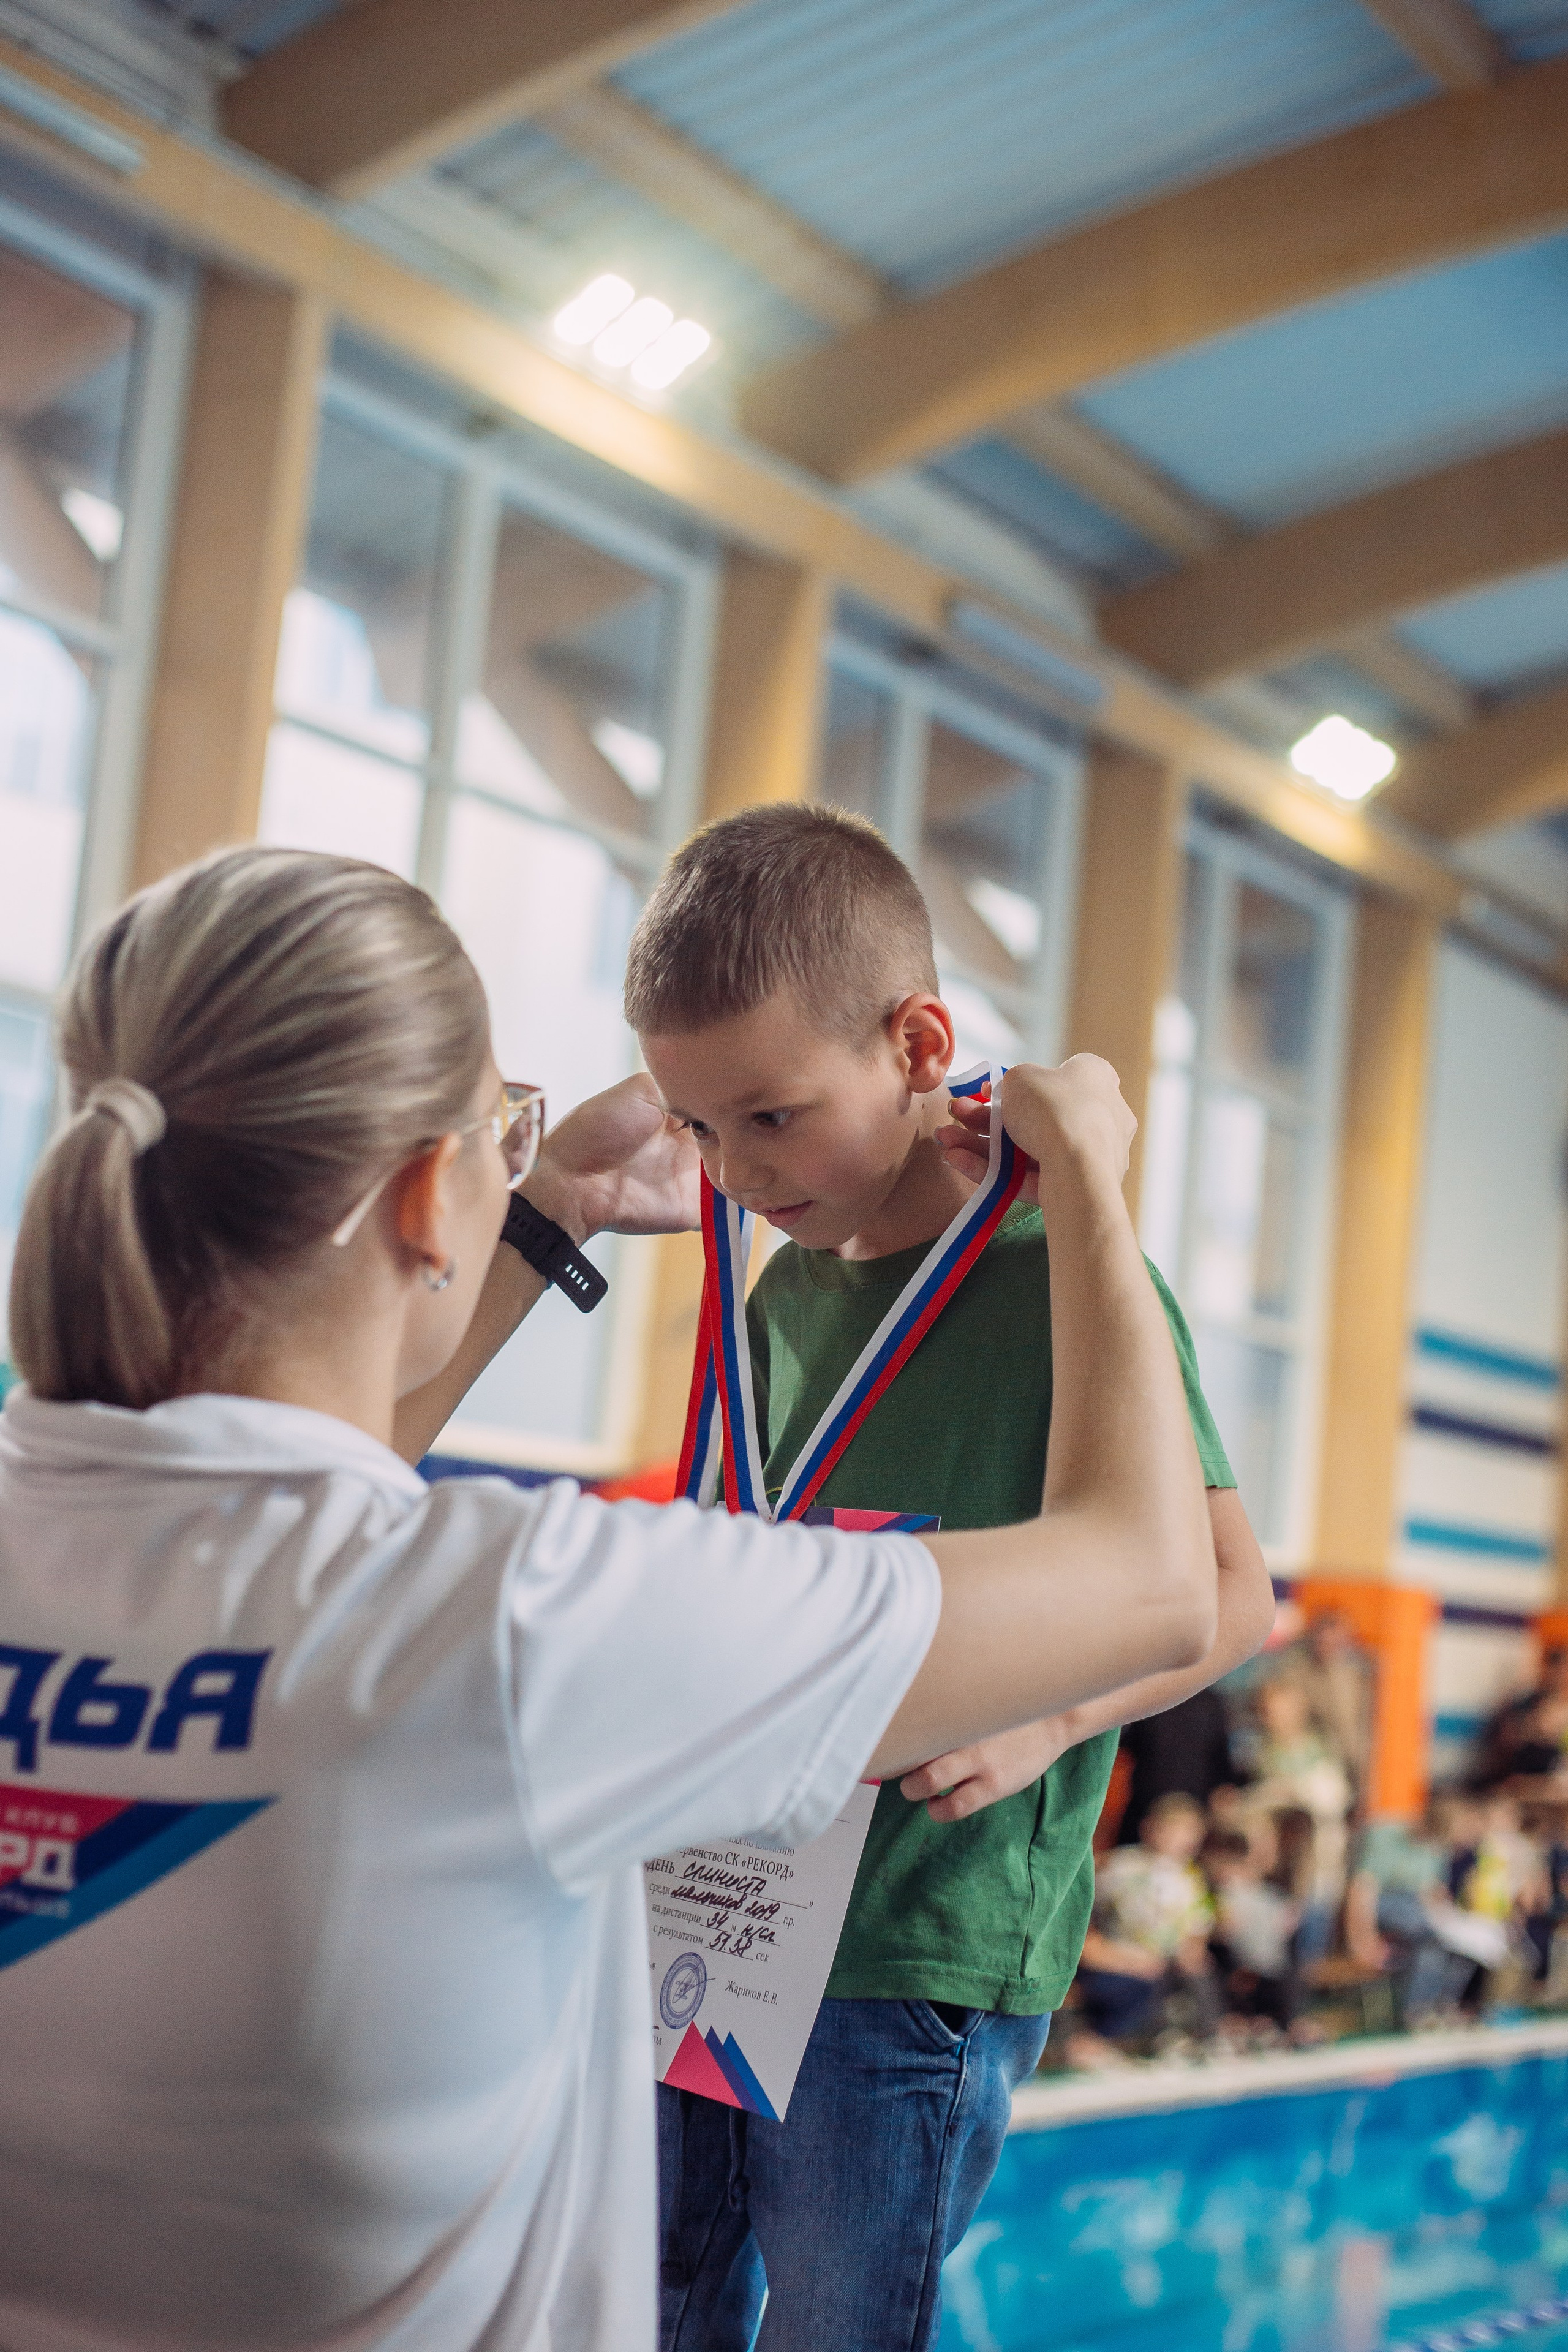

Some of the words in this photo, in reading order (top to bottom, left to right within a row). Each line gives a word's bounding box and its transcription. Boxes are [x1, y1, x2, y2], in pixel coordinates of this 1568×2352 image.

[676, 1846, 723, 1863] ервенство
[725, 1852, 741, 1866] СК
[741, 1856, 794, 1882] «РЕКОРД»
[649, 1883, 671, 1896] среди
[652, 1904, 661, 1913] на
[661, 1907, 702, 1924] дистанции
[657, 1926, 704, 1945] результатом
[756, 1953, 770, 1962] сек
[725, 1980, 761, 1999] Жариков
